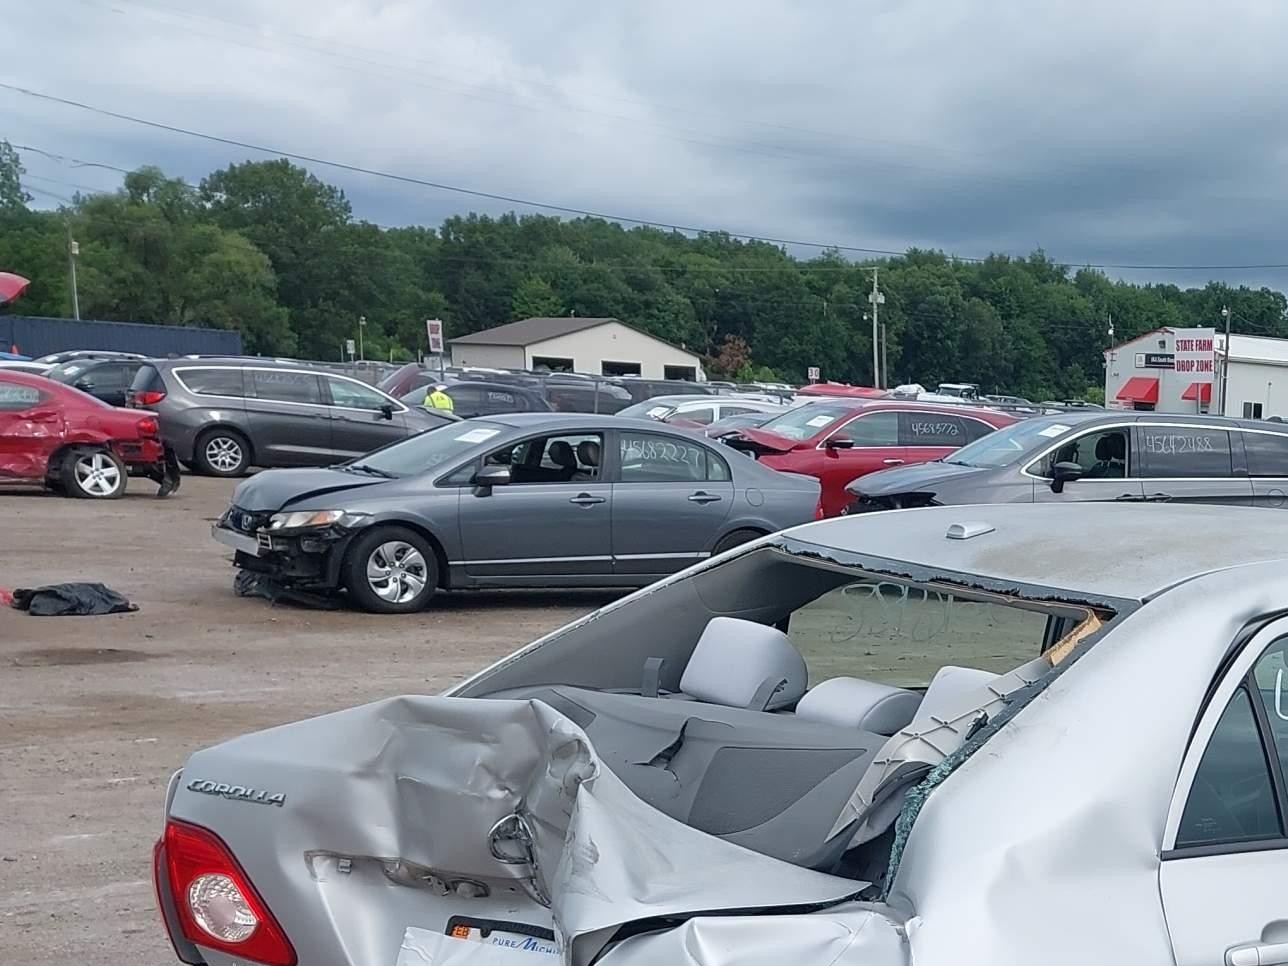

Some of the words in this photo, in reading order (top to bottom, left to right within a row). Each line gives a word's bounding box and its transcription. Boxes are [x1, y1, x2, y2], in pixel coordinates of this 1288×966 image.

[1176, 339, 1194, 352] STATE
[1196, 339, 1213, 352] FARM
[1177, 359, 1195, 372] DROP
[1196, 359, 1213, 372] ZONE
[186, 778, 286, 807] COROLLA
[492, 937, 516, 949] PURE
